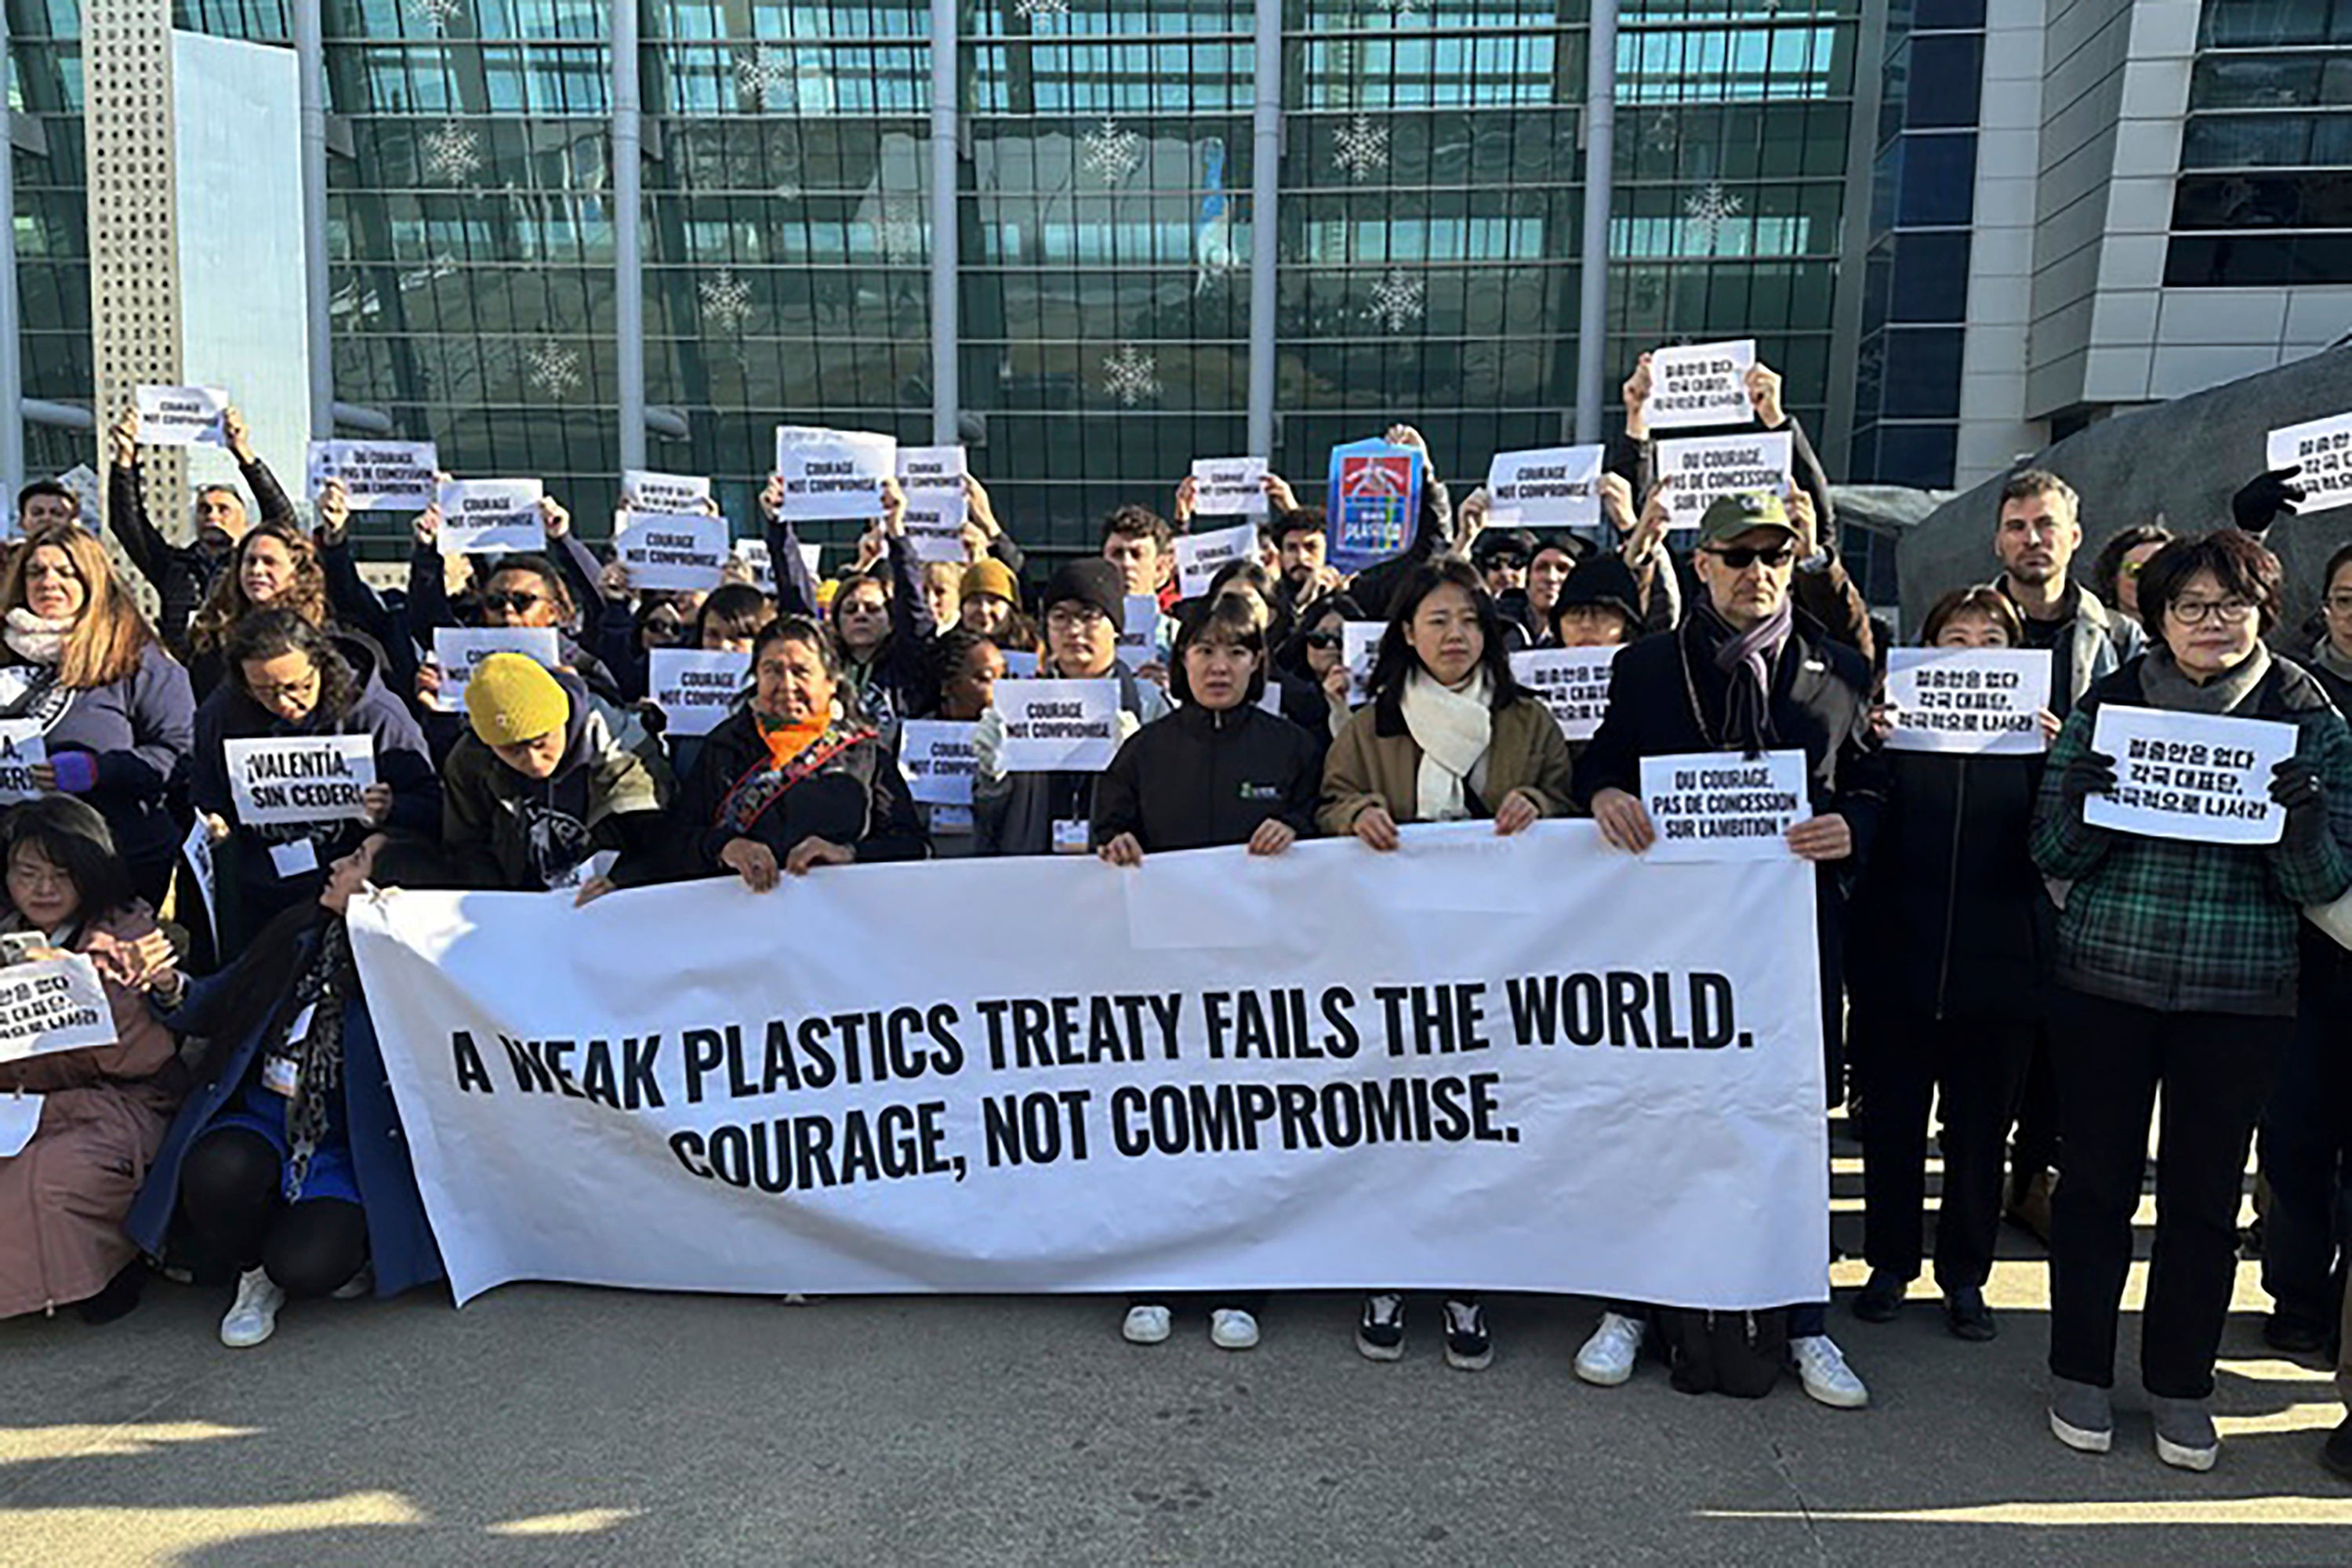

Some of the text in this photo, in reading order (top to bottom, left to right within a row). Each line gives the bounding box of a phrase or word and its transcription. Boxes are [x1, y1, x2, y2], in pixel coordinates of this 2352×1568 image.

[805, 460, 855, 476] COURAGE
[1682, 452, 1700, 470] DU
[1515, 464, 1567, 481] COURAGE
[1707, 470, 1784, 489] CONCESSION
[787, 477, 877, 493] NOT COMPROMISE
[1496, 482, 1589, 499] NOT COMPROMISE
[463, 498, 511, 513] COURAGE
[467, 513, 535, 528] COMPROMISE
[645, 532, 695, 548] COURAGE
[626, 549, 718, 568] NOT COMPROMISE
[681, 672, 736, 688] COURAGE
[1984, 671, 2020, 689] 없다
[659, 689, 682, 706] NOT
[1918, 691, 1952, 710] 각국
[1027, 702, 1083, 720] COURAGE
[1006, 721, 1111, 739] NOT COMPROMISE
[2129, 738, 2256, 771] 절충안은 없다
[909, 759, 931, 774] NOT
[2129, 763, 2171, 787] 각국
[1675, 770, 1697, 790] DU
[250, 785, 289, 809] SIN
[1652, 792, 1798, 815] PAS DE CONCESSION
[2205, 796, 2269, 821] 나서라
[1665, 818, 1696, 840] SUR
[452, 1031, 494, 1094] A
[682, 1003, 965, 1104] PLASTICS
[976, 991, 1183, 1071] TREATY
[1202, 986, 1360, 1060] FAILS
[1373, 982, 1490, 1056] THE
[1505, 971, 1754, 1050] WORLD.
[668, 1073, 1521, 1196] COURAGE, NOT COMPROMISE.
